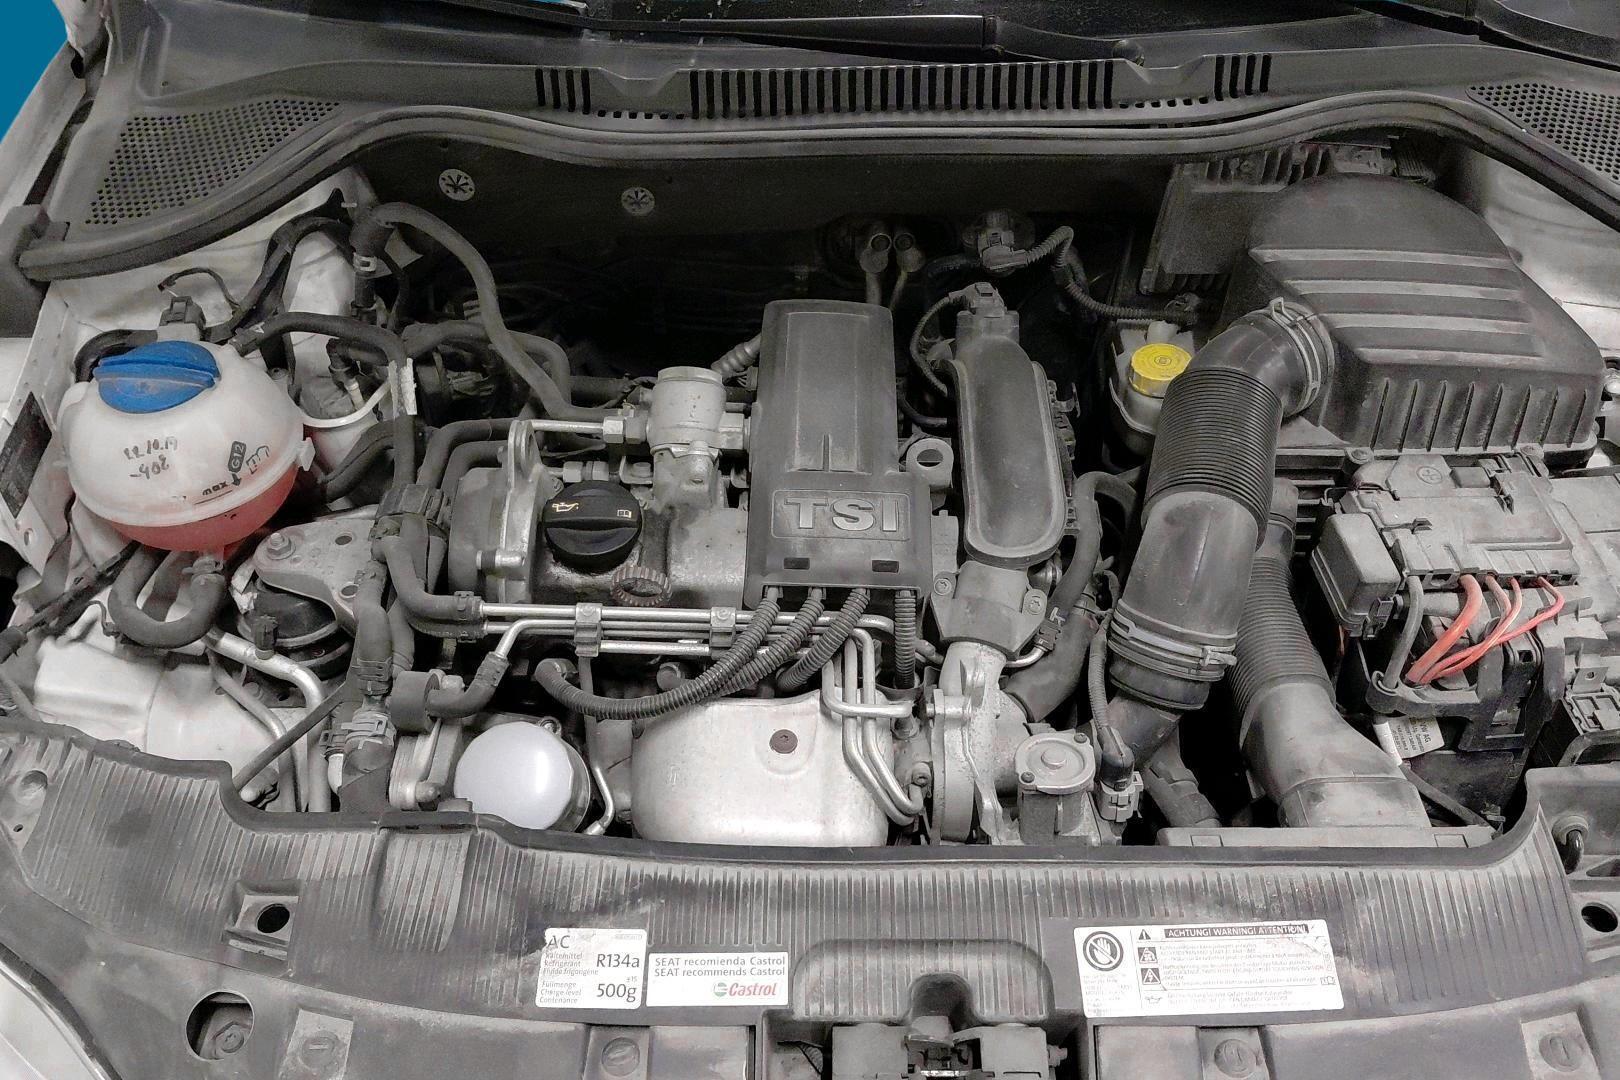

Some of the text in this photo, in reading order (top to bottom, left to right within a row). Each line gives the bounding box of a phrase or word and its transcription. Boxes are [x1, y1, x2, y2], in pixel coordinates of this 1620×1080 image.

[231, 443, 244, 469] G12
[202, 481, 228, 496] max
[783, 496, 900, 532] TSI
[1168, 928, 1211, 938] ACHTUNG!
[1213, 927, 1256, 936] WARNING!
[546, 935, 571, 949] AC
[596, 953, 640, 968] R134a
[655, 956, 786, 967] SEAT recomienda Castrol
[654, 966, 785, 977] SEAT recommends Castrol
[596, 983, 638, 1003] 500g
[729, 982, 778, 997] Castrol
